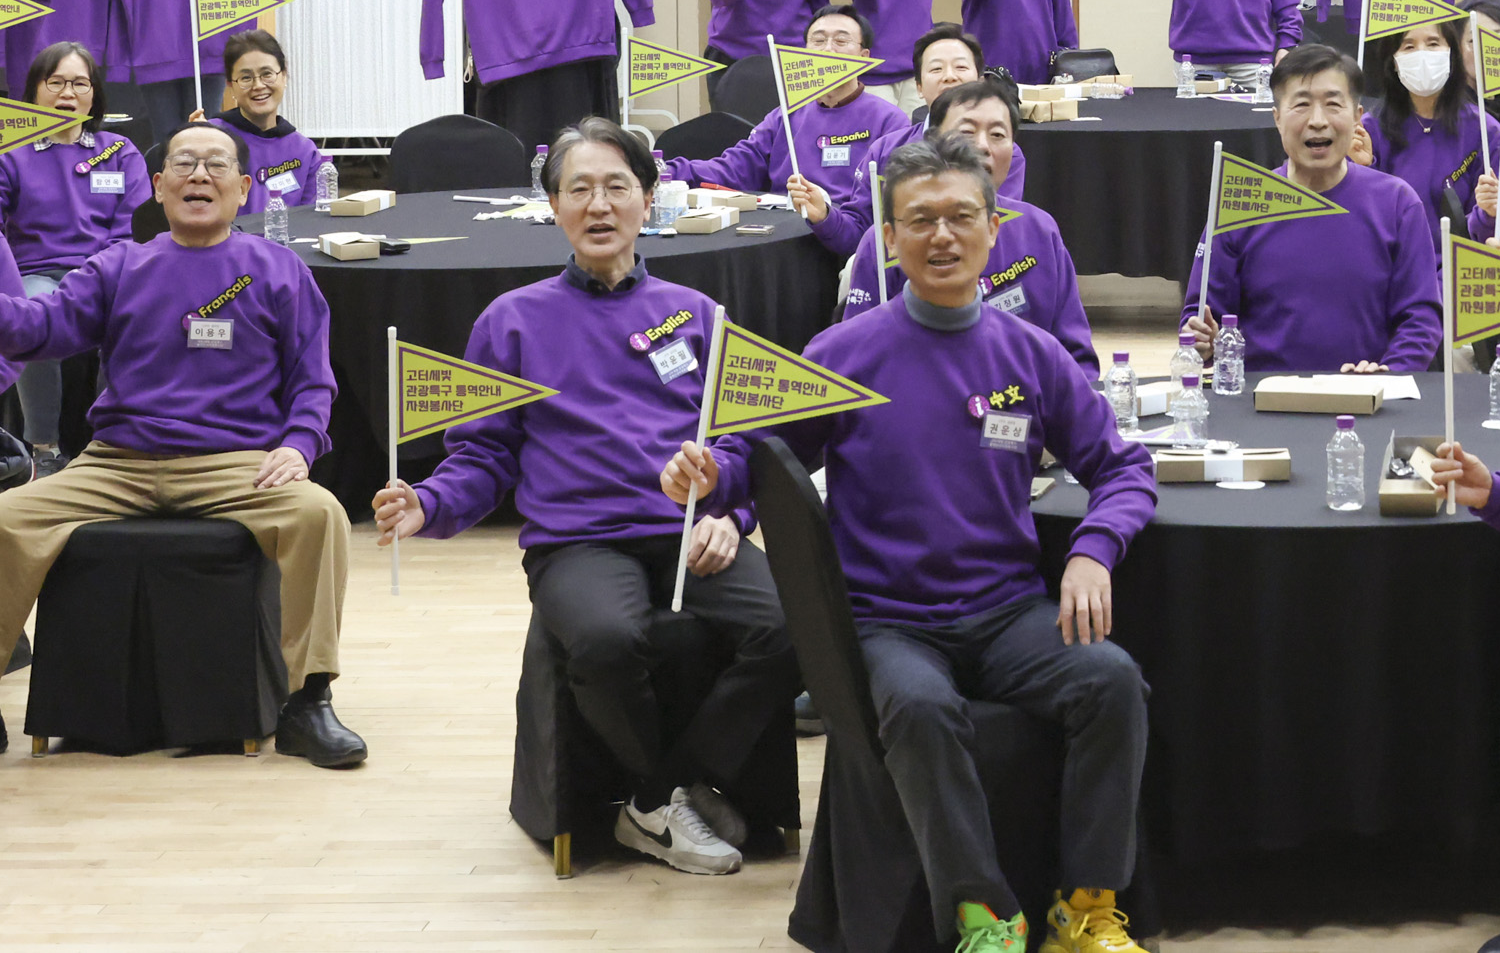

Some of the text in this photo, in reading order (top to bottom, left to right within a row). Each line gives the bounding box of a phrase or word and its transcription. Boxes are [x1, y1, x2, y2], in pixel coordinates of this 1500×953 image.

[200, 0, 228, 11] 관광특구
[1372, 1, 1434, 15] 관광특구 통역안내
[200, 10, 236, 21] 자원봉사단
[1371, 12, 1409, 23] 자원봉사단
[633, 53, 661, 61] 고터세빛
[632, 62, 691, 71] 관광특구 통역안내
[783, 58, 814, 72] 고터세빛
[785, 62, 847, 82] 관광특구 통역안내
[632, 72, 668, 80] 자원봉사단
[787, 77, 825, 92] 자원봉사단
[830, 130, 870, 145] Español
[87, 141, 125, 166] English
[268, 159, 300, 176] English
[1224, 174, 1263, 188] 고터세빛
[1223, 186, 1302, 205] 관광특구 통역안내
[1221, 199, 1270, 214] 자원봉사단
[990, 256, 1037, 286] English
[198, 274, 252, 318] Français
[644, 310, 693, 341] English
[726, 354, 777, 375] 고터세빛
[406, 369, 452, 382] 고터세빛
[406, 384, 501, 397] 관광특구 통역안내
[723, 371, 828, 398] 관광특구 통역안내
[721, 389, 785, 410] 자원봉사단
[989, 385, 1025, 409] 中文
[406, 400, 464, 412] 자원봉사단
